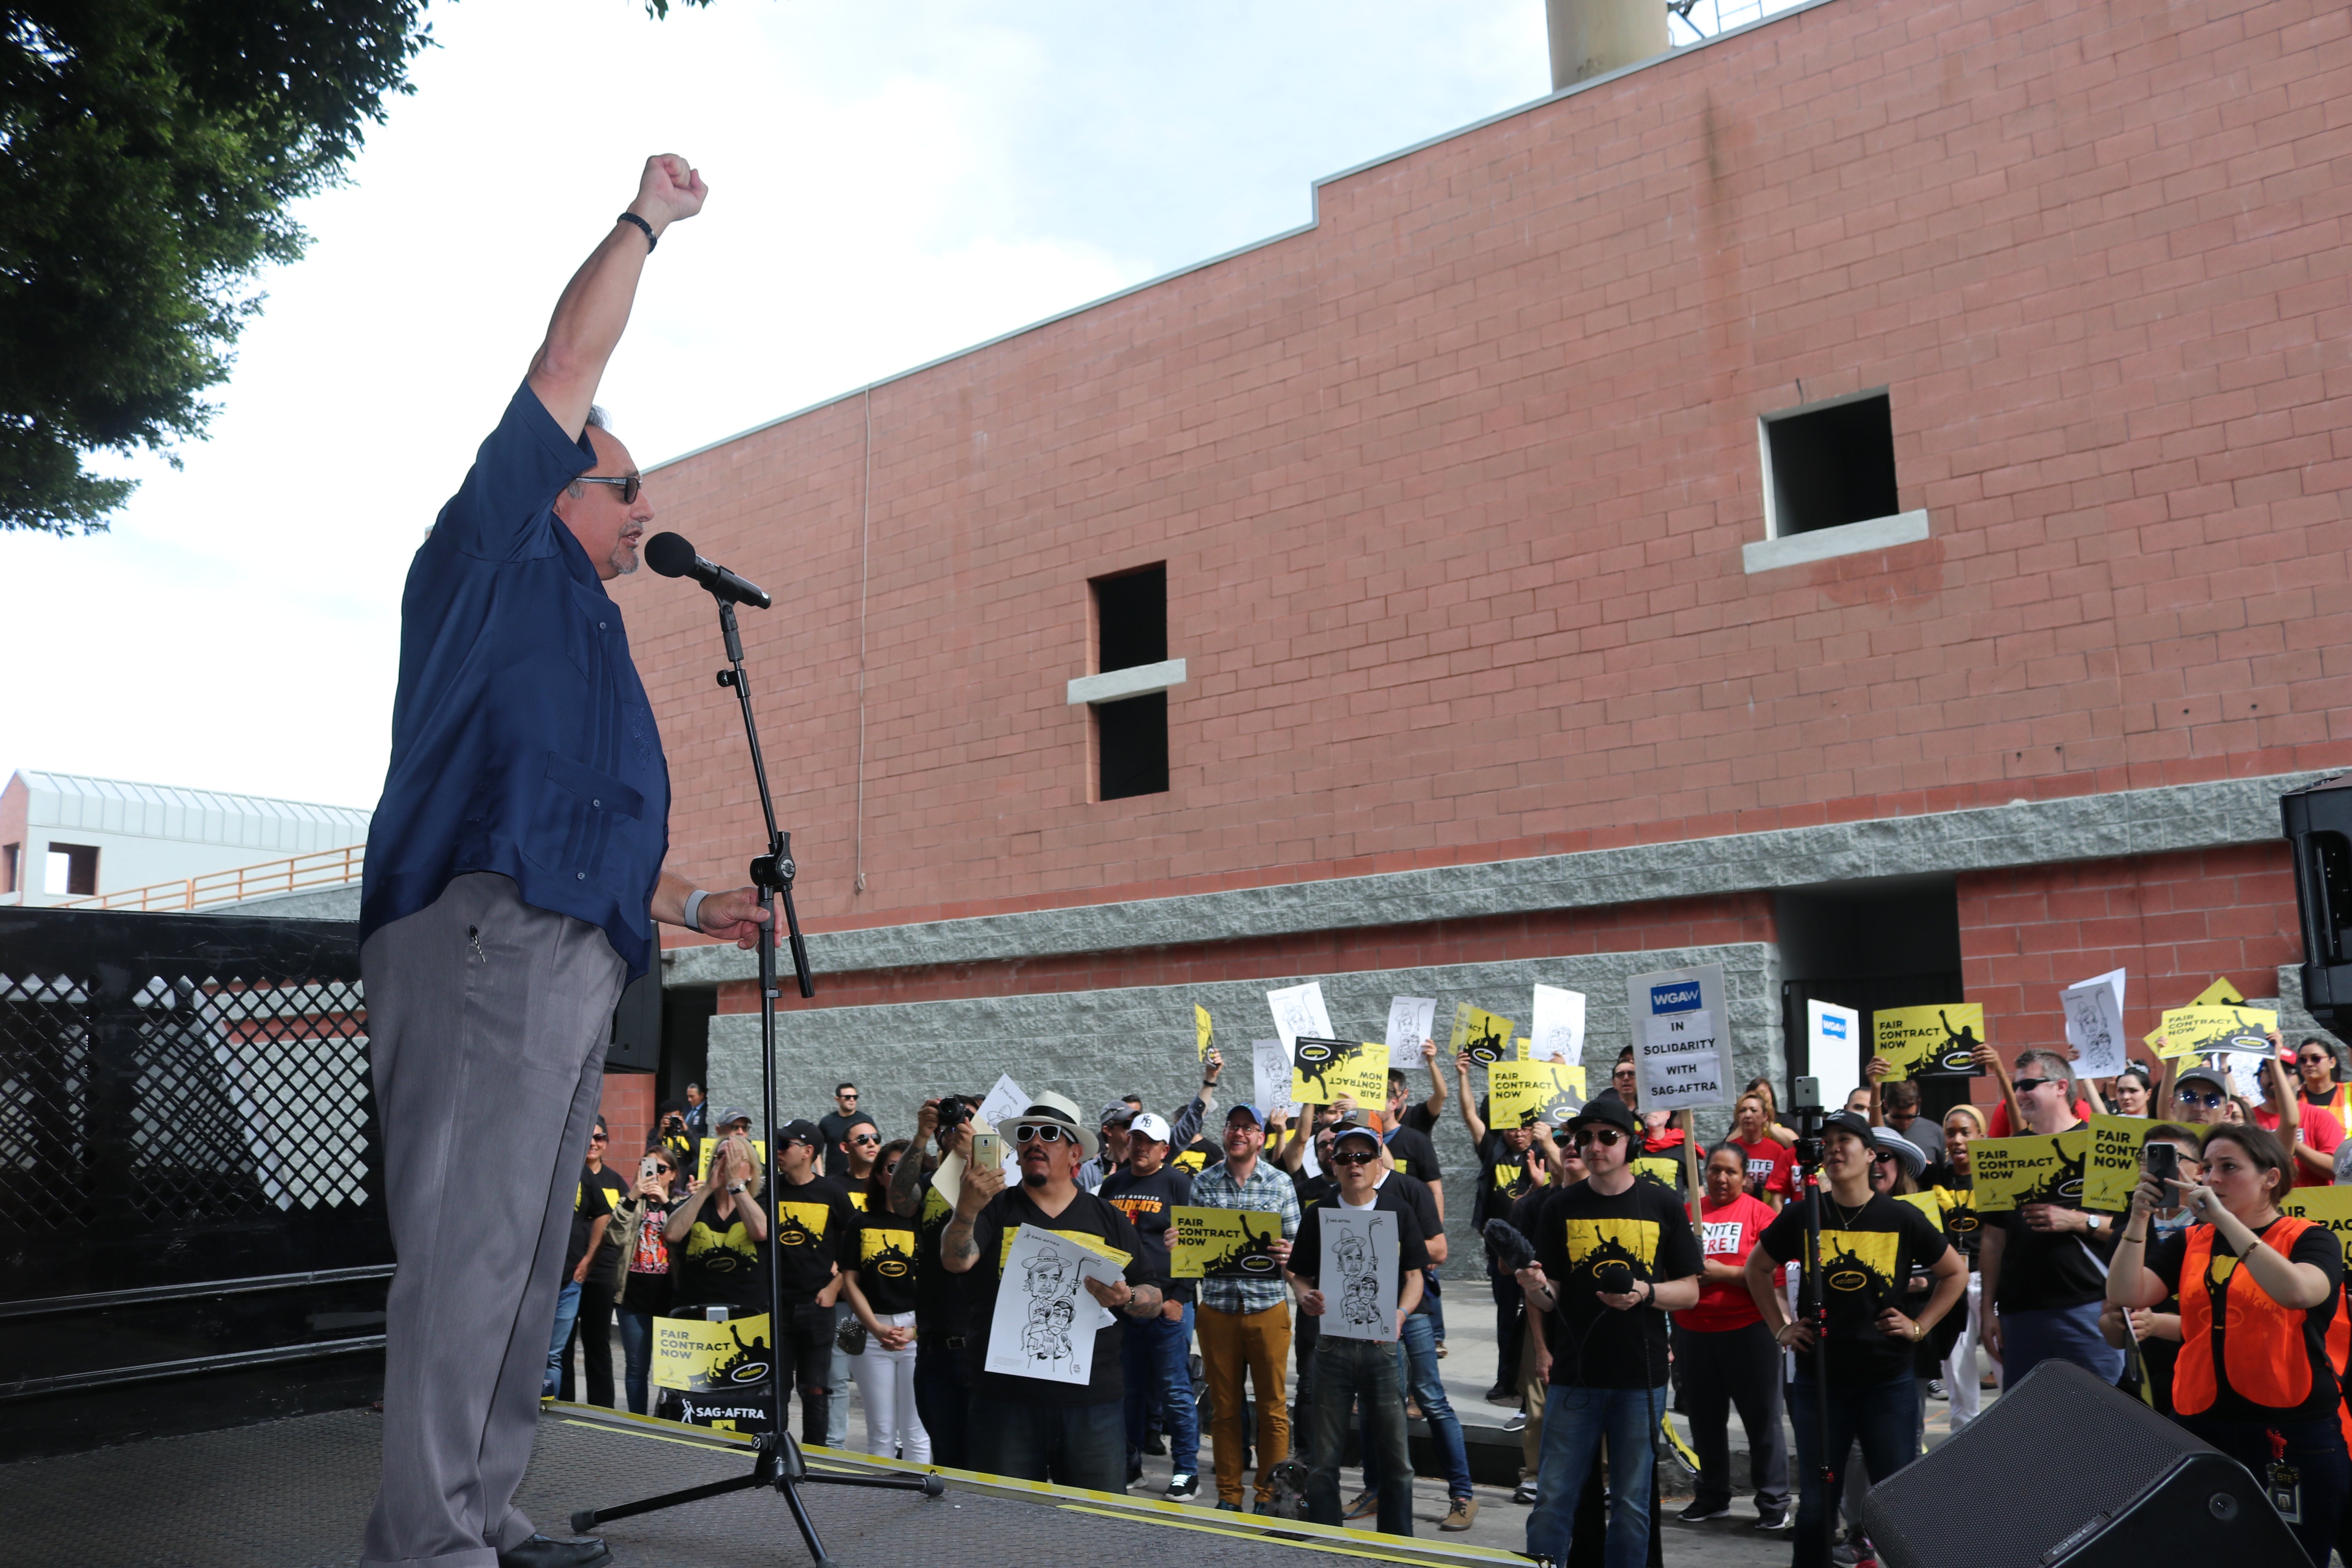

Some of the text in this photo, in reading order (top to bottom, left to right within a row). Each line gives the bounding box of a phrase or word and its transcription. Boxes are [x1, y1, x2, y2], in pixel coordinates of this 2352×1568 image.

[1653, 990, 1699, 1005] WGAW
[2168, 1014, 2194, 1024] FAIR
[2168, 1018, 2232, 1030] CONTRACT
[1671, 1022, 1684, 1031] IN
[1823, 1020, 1846, 1032] WGAW
[1880, 1020, 1903, 1030] FAIR
[1880, 1028, 1940, 1040] CONTRACT
[2168, 1027, 2195, 1036] NOW
[1644, 1038, 1715, 1055] SOLIDARITY
[1880, 1040, 1906, 1050] NOW
[1666, 1064, 1697, 1075] WITH
[1360, 1072, 1382, 1080] NOW
[1330, 1077, 1381, 1090] CONTRACT
[1651, 1082, 1717, 1096] SAG-AFTRA
[1361, 1090, 1380, 1099] FAIR
[2096, 1130, 2130, 1143] FAIR
[1977, 1151, 2007, 1159] FAIR
[2095, 1143, 2140, 1157] CONT
[1748, 1161, 1772, 1171] ITE
[1978, 1157, 2054, 1170] CONTRACT
[2094, 1156, 2132, 1169] NOW
[1980, 1171, 2013, 1180] NOW
[2278, 1206, 2305, 1217] AIR
[1178, 1218, 1203, 1226] FAIR
[1179, 1228, 1240, 1238] CONTRACT
[1703, 1224, 1739, 1236] NITE
[661, 1329, 689, 1339] FAIR
[661, 1339, 730, 1351] CONTRACT
[661, 1348, 691, 1359] NOW
